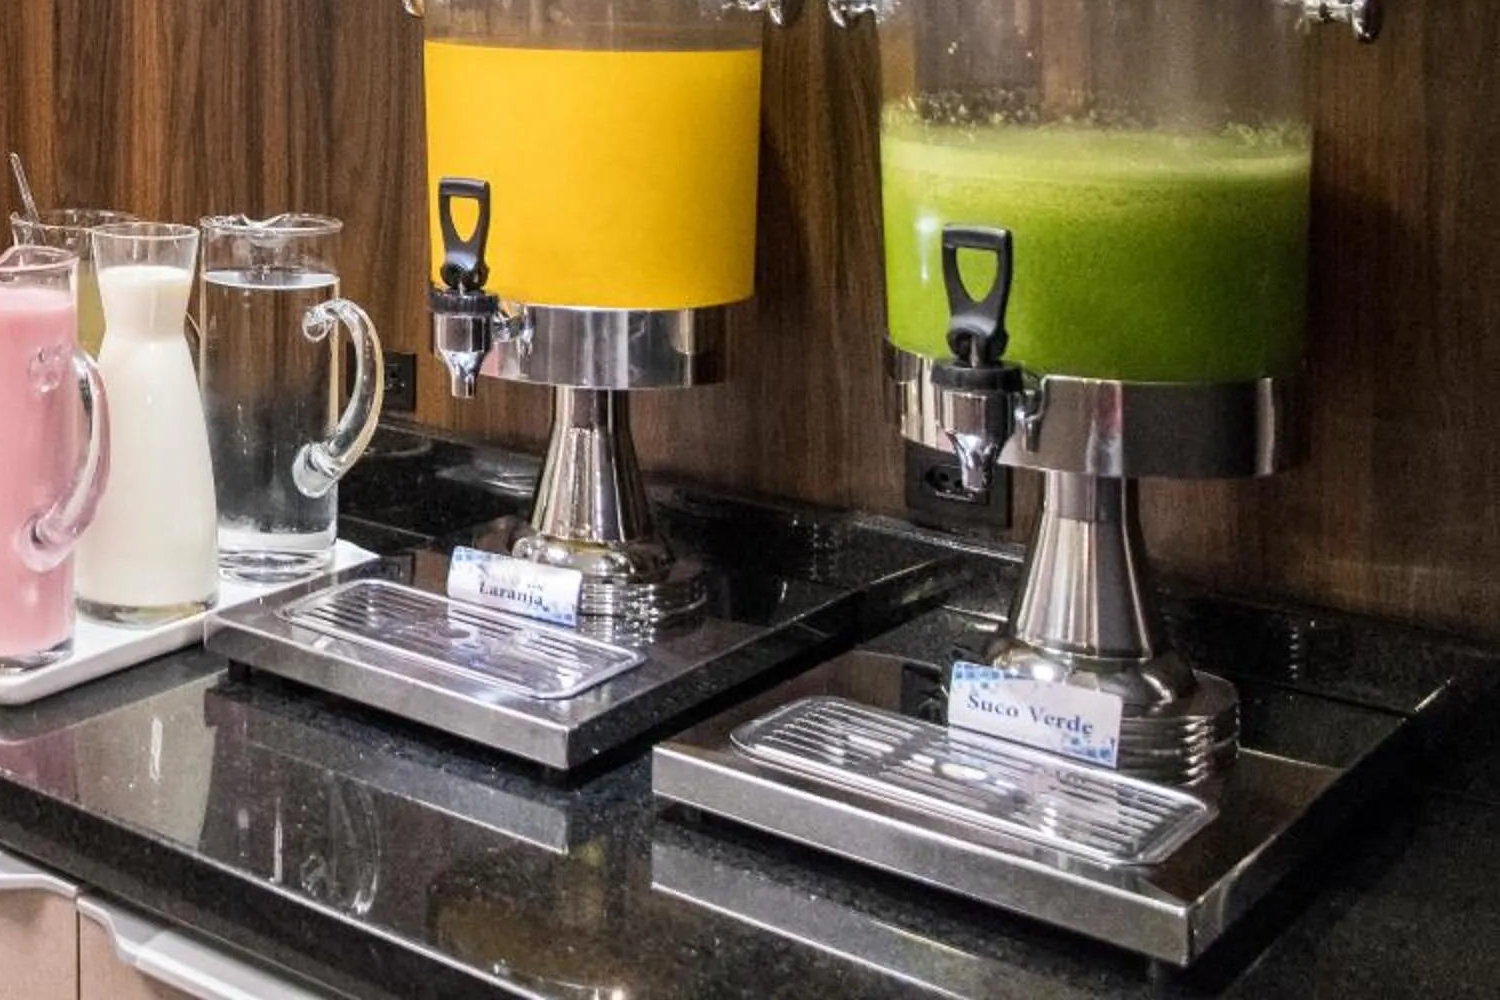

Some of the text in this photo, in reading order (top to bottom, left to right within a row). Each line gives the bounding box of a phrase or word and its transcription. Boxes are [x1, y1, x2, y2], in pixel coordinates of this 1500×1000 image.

[479, 580, 543, 607] Laranja
[966, 694, 1094, 735] Suco Verde
